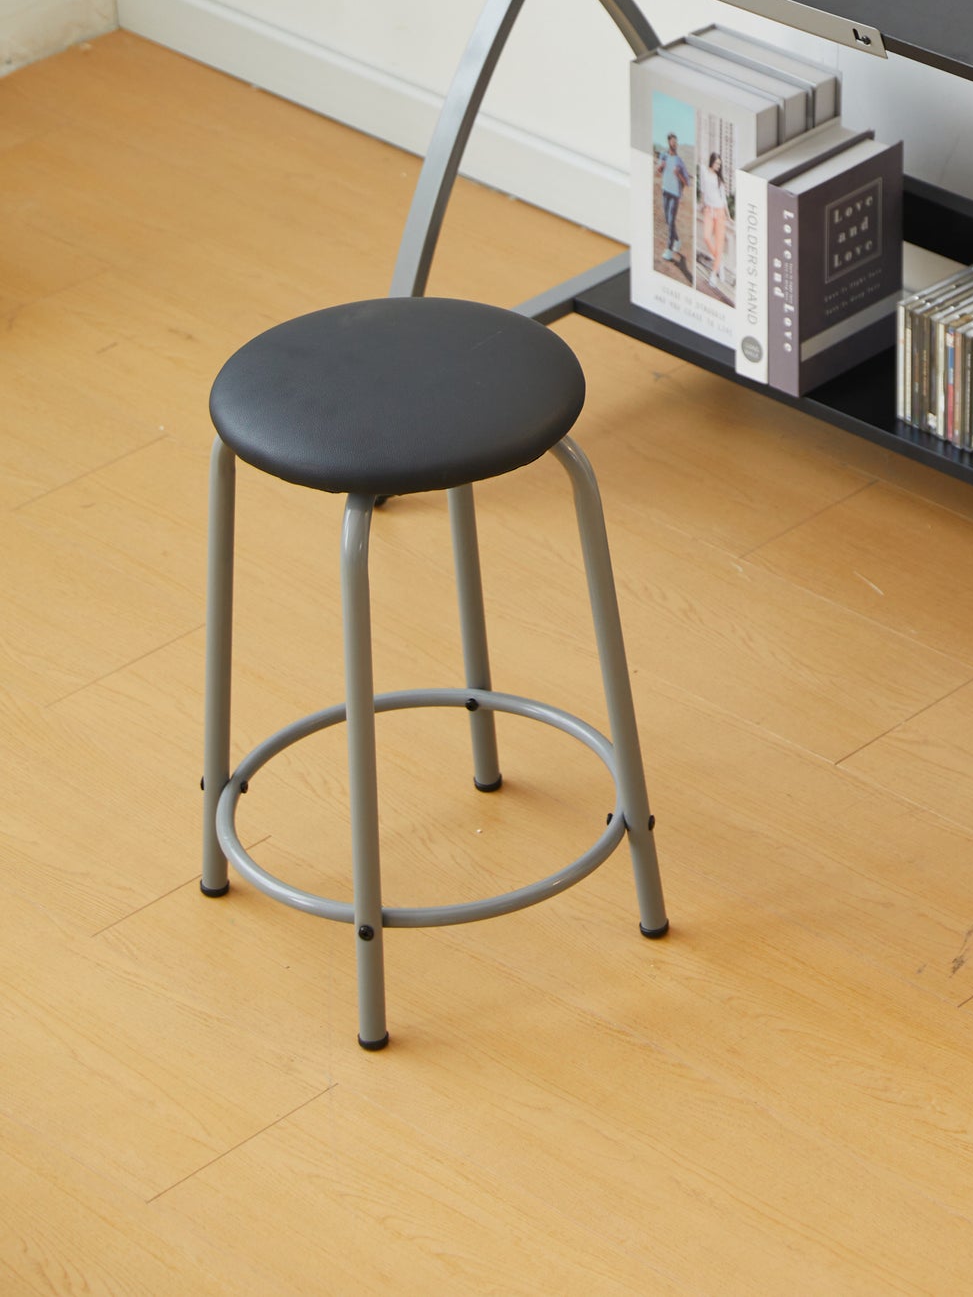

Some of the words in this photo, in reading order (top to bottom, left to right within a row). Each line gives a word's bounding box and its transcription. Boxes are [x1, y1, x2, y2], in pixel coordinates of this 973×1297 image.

[833, 196, 873, 224] Love
[837, 216, 869, 243] and
[746, 202, 758, 278] HOLDER'S
[783, 209, 795, 260] Love
[833, 240, 873, 268] Love
[773, 258, 785, 298] and
[746, 281, 758, 325] HAND
[783, 303, 795, 353] Love
